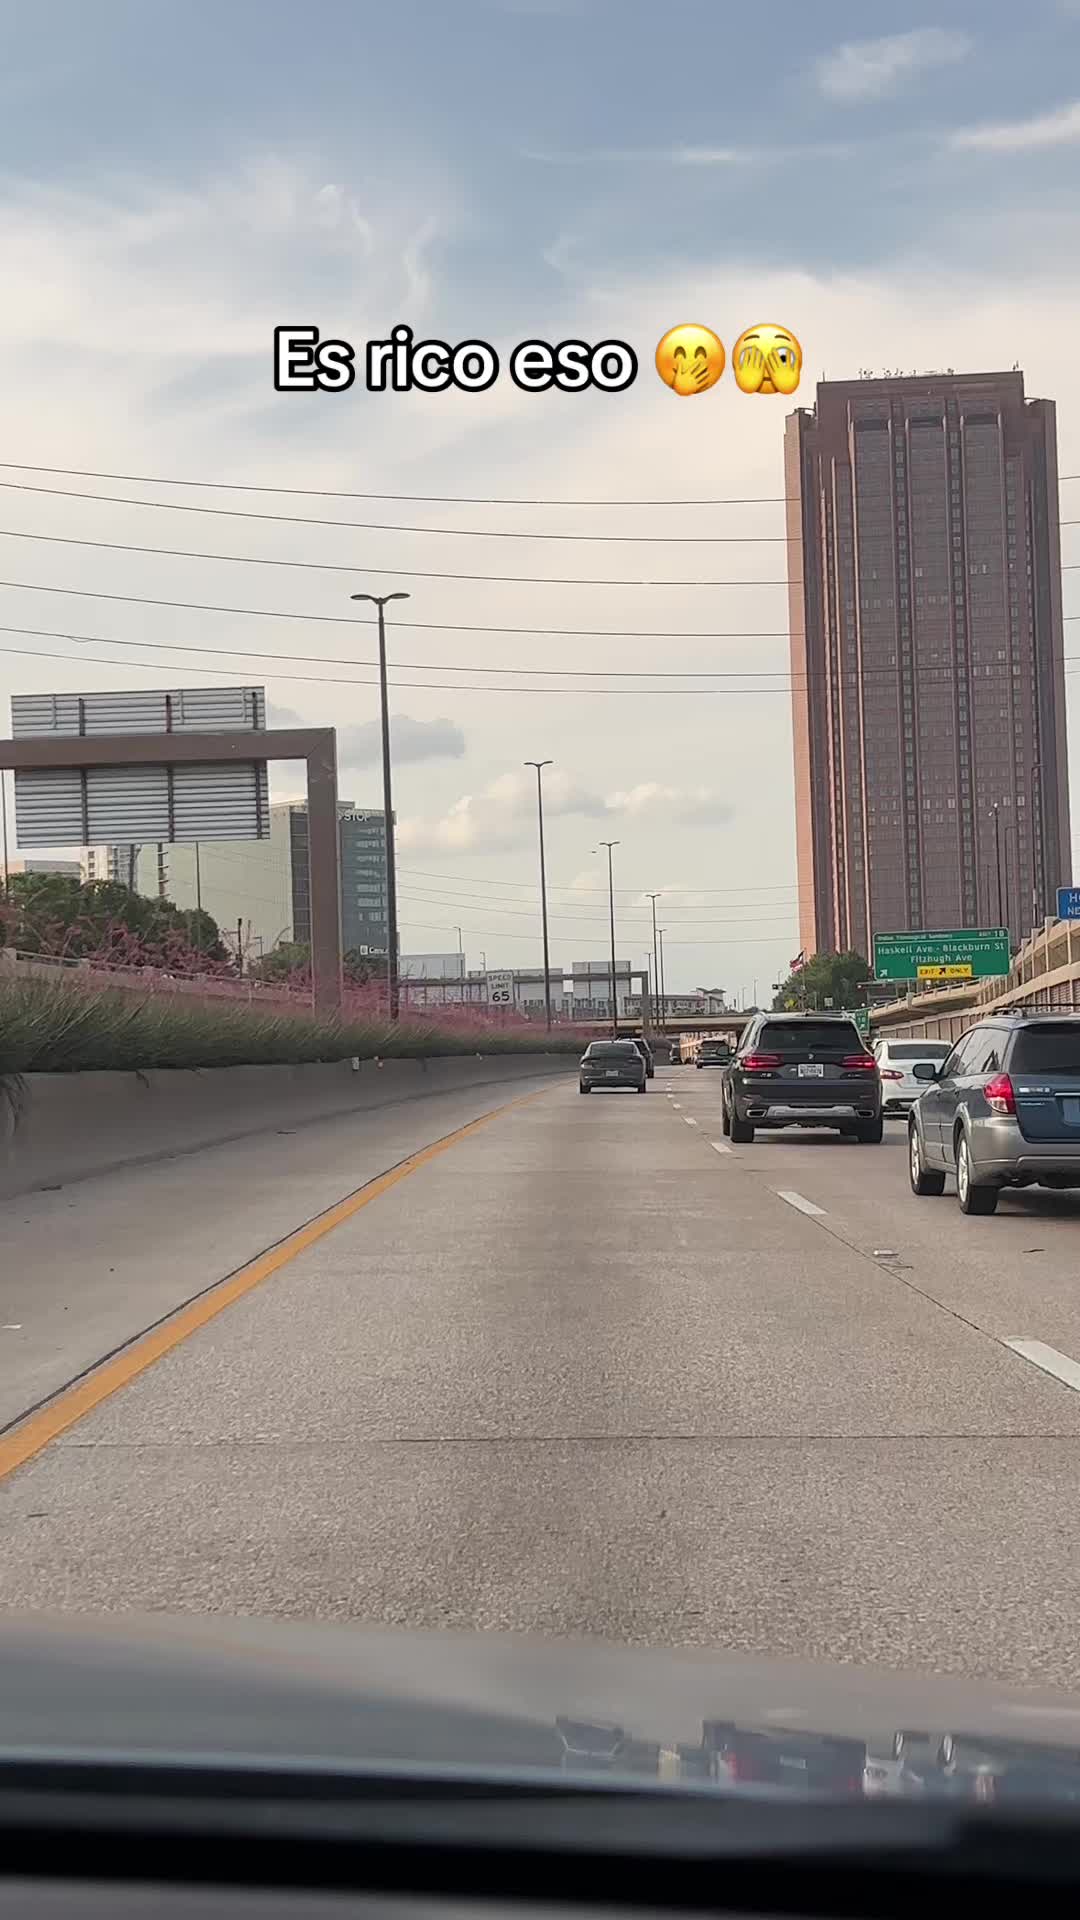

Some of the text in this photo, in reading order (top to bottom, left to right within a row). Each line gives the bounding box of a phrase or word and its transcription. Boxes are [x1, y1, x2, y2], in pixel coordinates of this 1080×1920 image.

[1069, 892, 1080, 903] H
[878, 945, 912, 955] Haskell
[916, 945, 933, 953] Ave
[942, 943, 990, 952] Blackburn
[994, 942, 1004, 950] St
[910, 953, 972, 964] Fitzhugh Ave
[488, 974, 511, 982] SPEED
[492, 990, 510, 1002] 65
